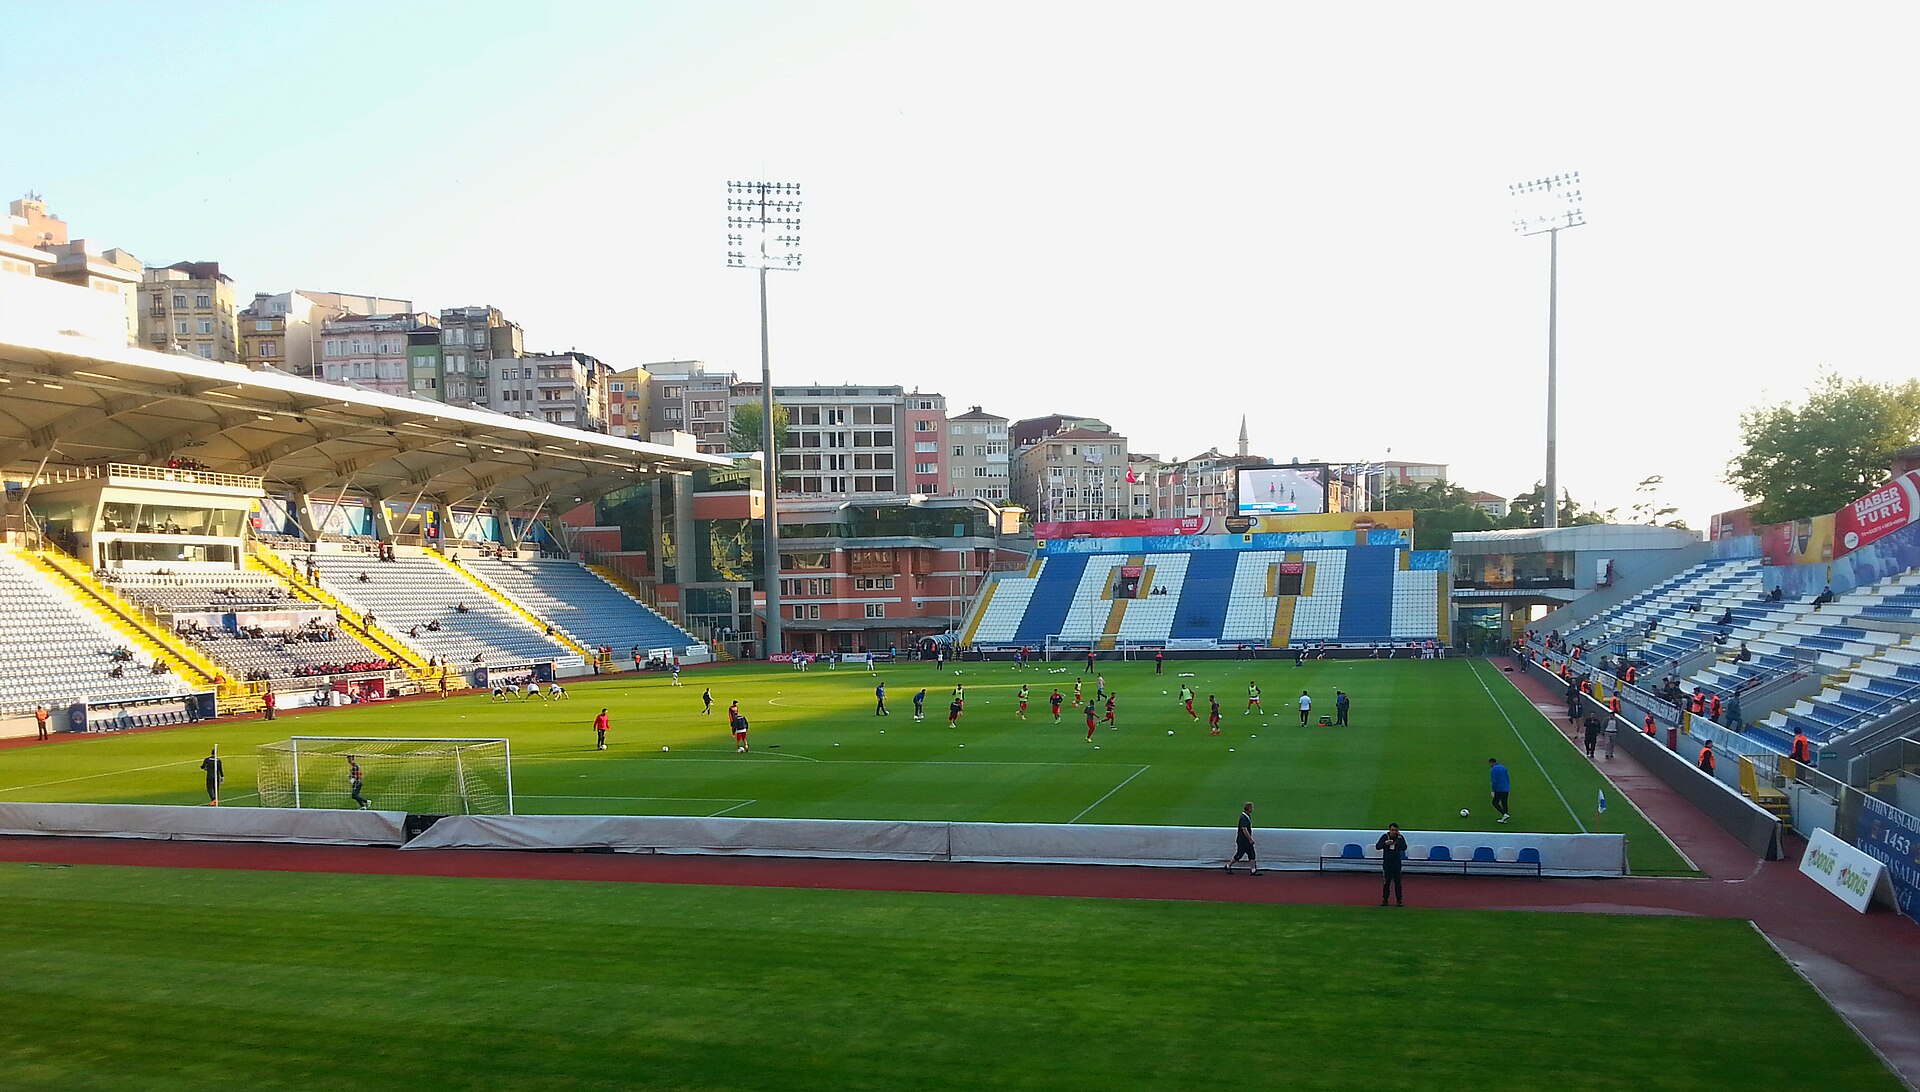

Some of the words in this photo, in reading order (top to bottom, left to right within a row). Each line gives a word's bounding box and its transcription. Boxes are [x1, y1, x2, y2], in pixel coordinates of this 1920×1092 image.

[1855, 487, 1899, 513] HABER
[1888, 806, 1920, 835] BAŞLADI
[1883, 829, 1910, 855] 1453
